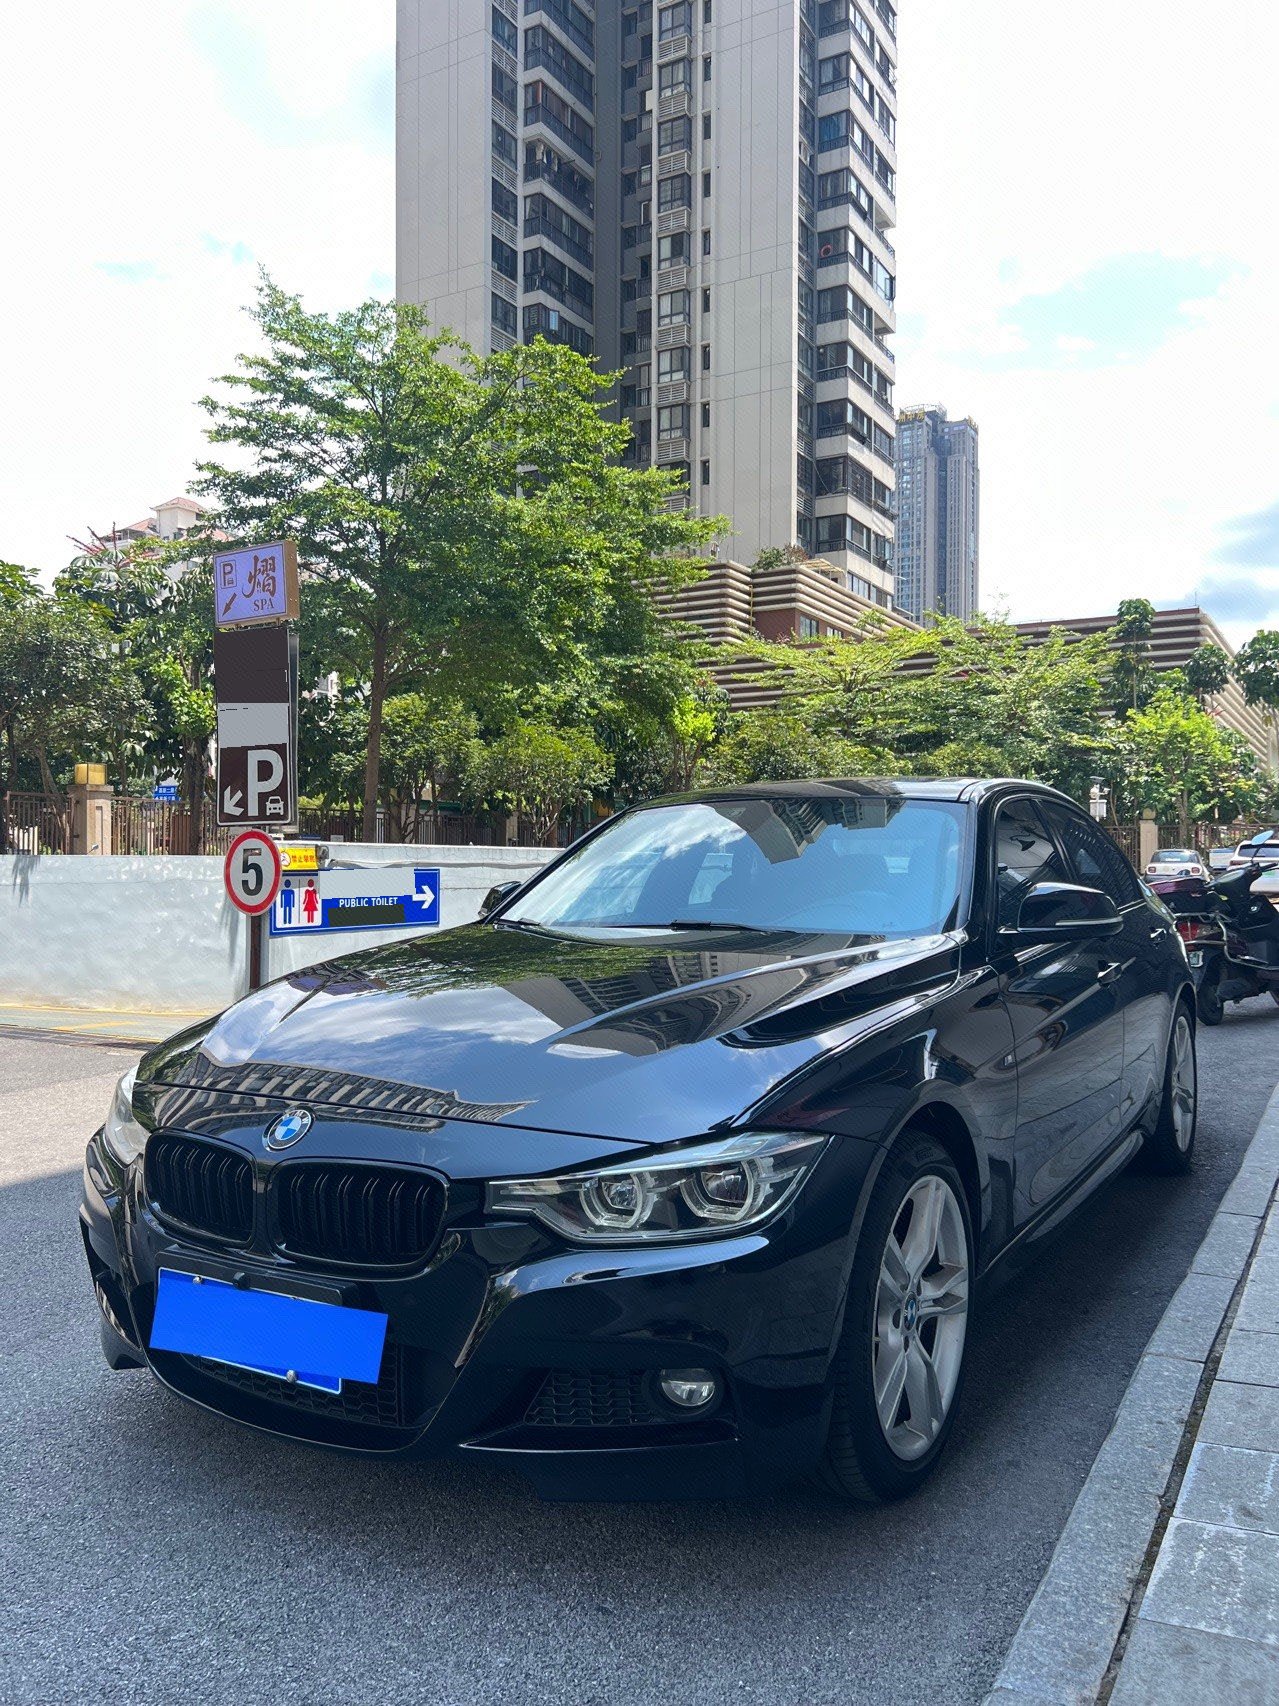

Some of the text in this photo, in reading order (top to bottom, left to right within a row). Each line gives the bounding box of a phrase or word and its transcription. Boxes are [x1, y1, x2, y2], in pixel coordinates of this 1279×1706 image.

[253, 598, 275, 611] SPA
[247, 749, 283, 816] P
[241, 848, 263, 896] 5
[339, 896, 398, 907] PUBLIC TOILET
